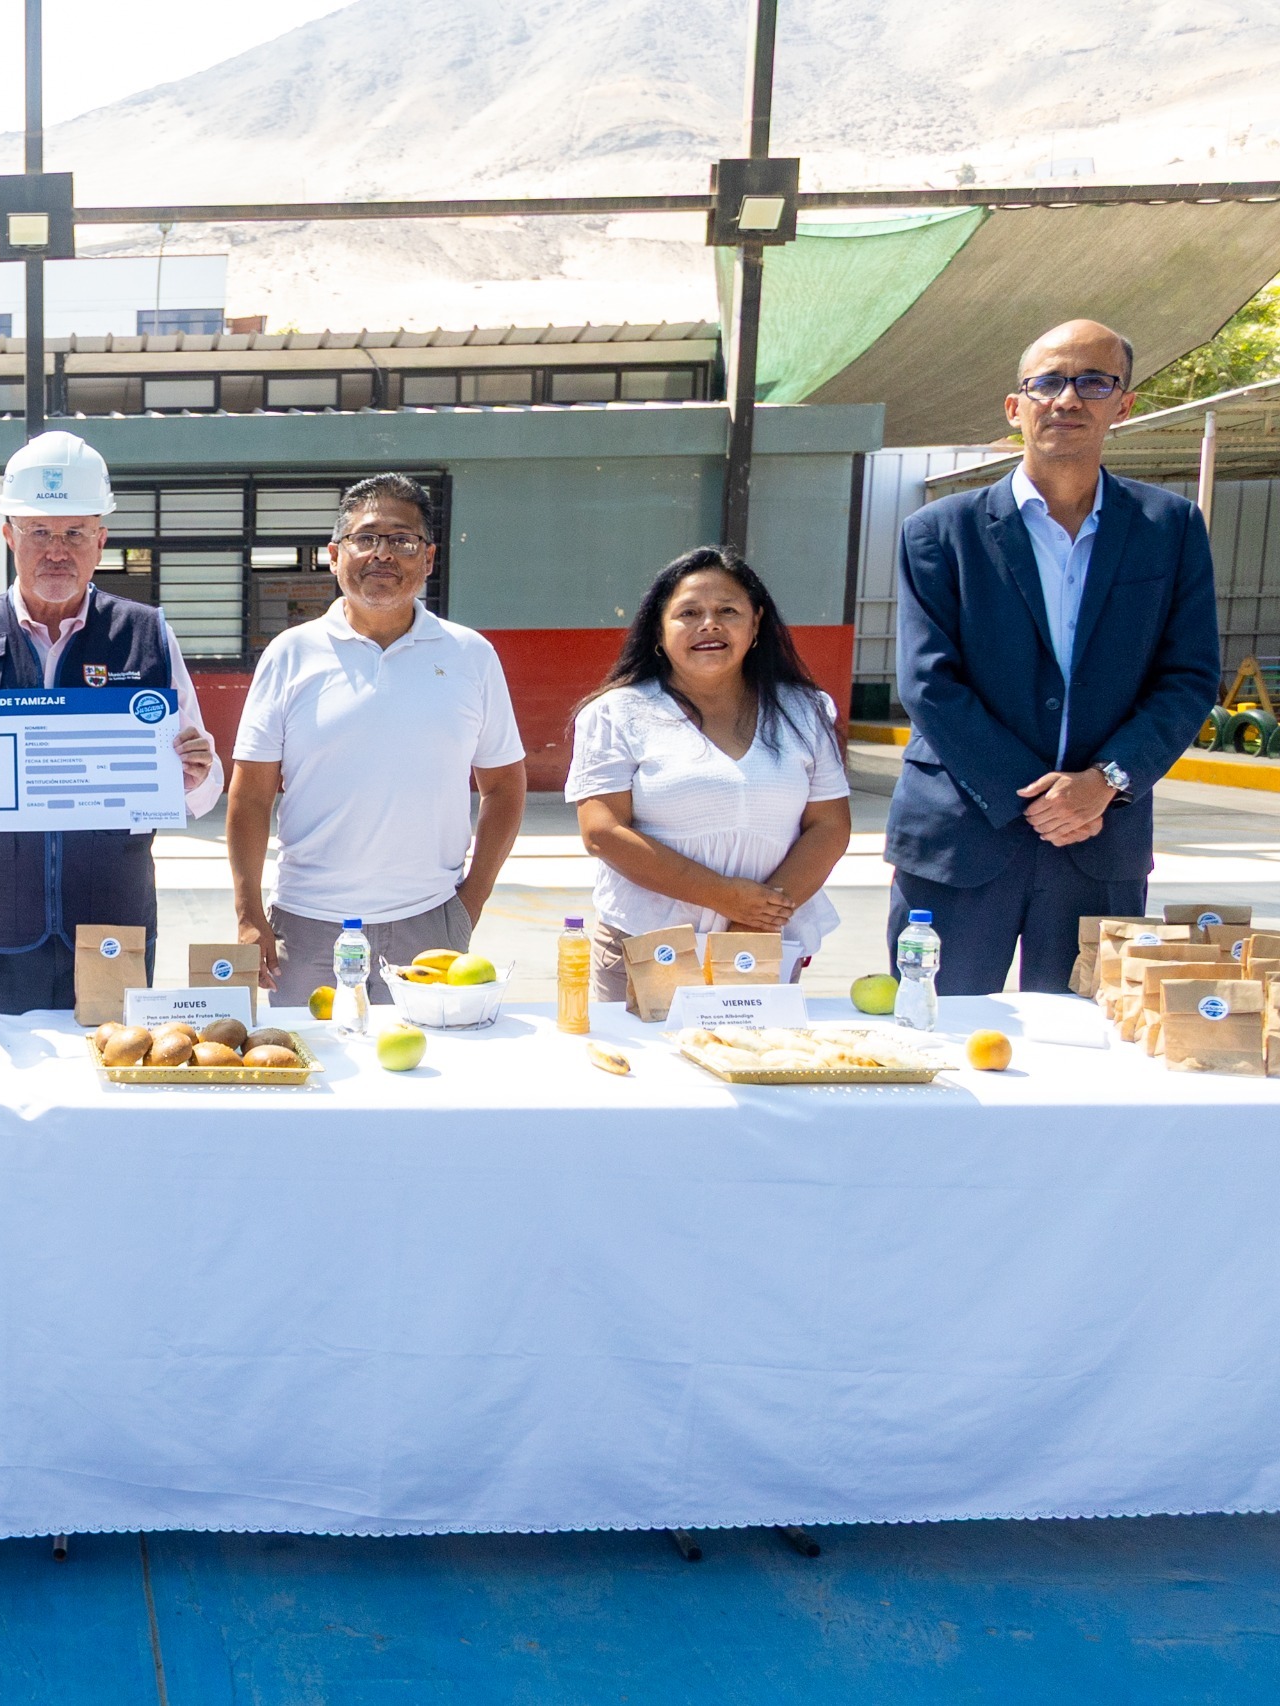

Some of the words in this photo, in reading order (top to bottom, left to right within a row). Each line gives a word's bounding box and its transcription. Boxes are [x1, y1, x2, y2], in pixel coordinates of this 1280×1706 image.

[0, 698, 12, 706] DE
[14, 696, 66, 706] TAMIZAJE
[173, 1000, 207, 1009] JUEVES
